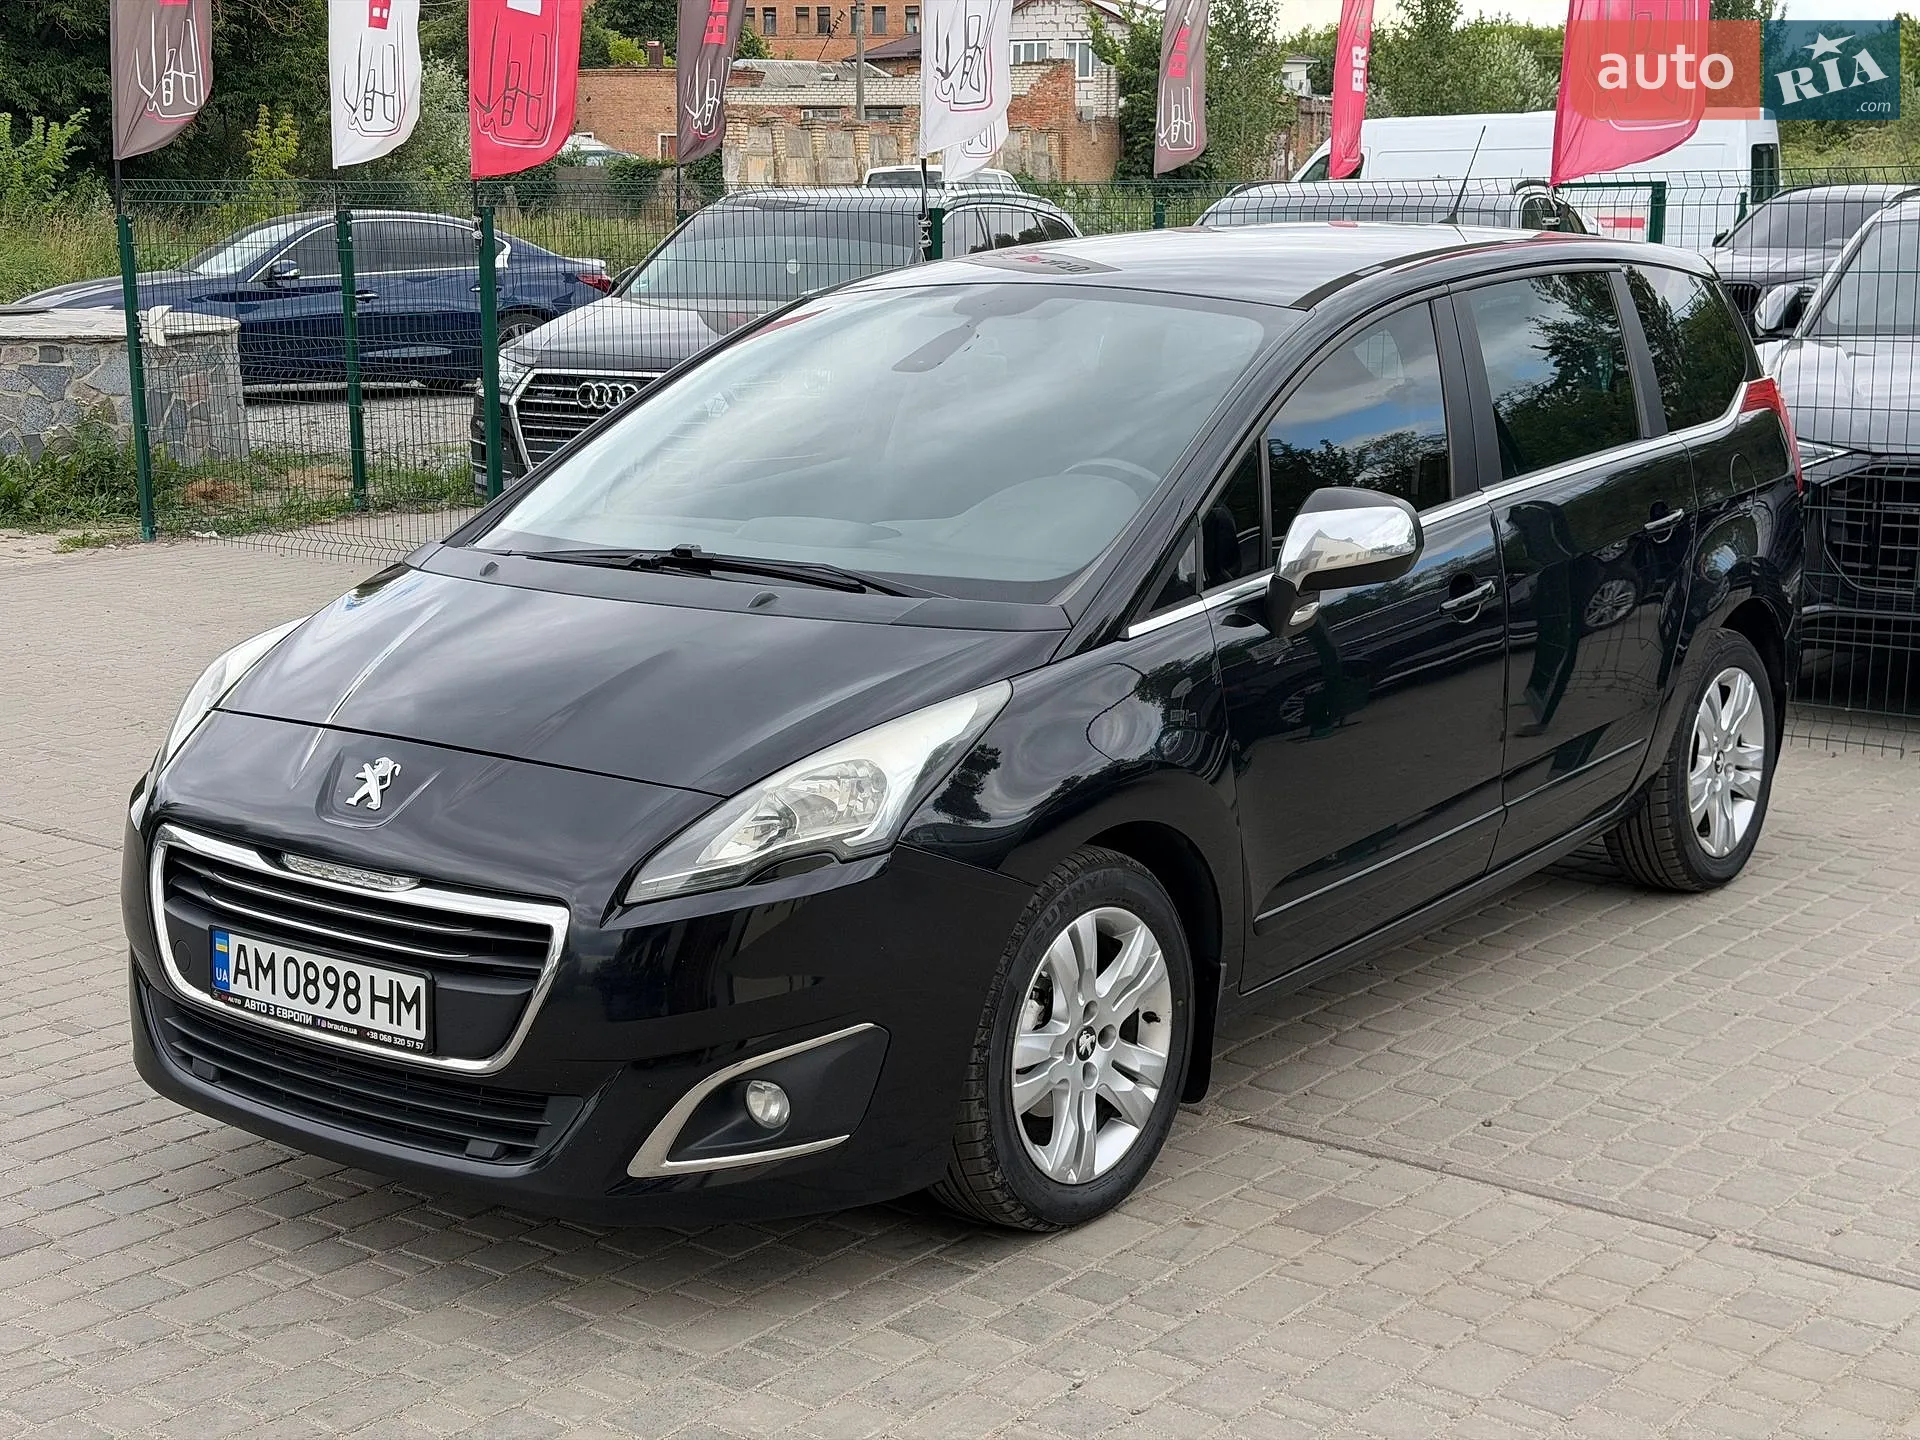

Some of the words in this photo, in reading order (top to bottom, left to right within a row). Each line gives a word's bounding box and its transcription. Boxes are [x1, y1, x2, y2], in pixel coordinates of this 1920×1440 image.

[1352, 45, 1367, 92] BR
[216, 967, 229, 983] UA
[232, 943, 276, 996] AM
[283, 956, 361, 1015] 0898
[369, 975, 421, 1032] HM
[243, 998, 267, 1014] АВТО
[366, 1030, 378, 1040] +38
[393, 1036, 406, 1046] 320
[406, 1040, 415, 1048] 57
[415, 1042, 424, 1050] 57
